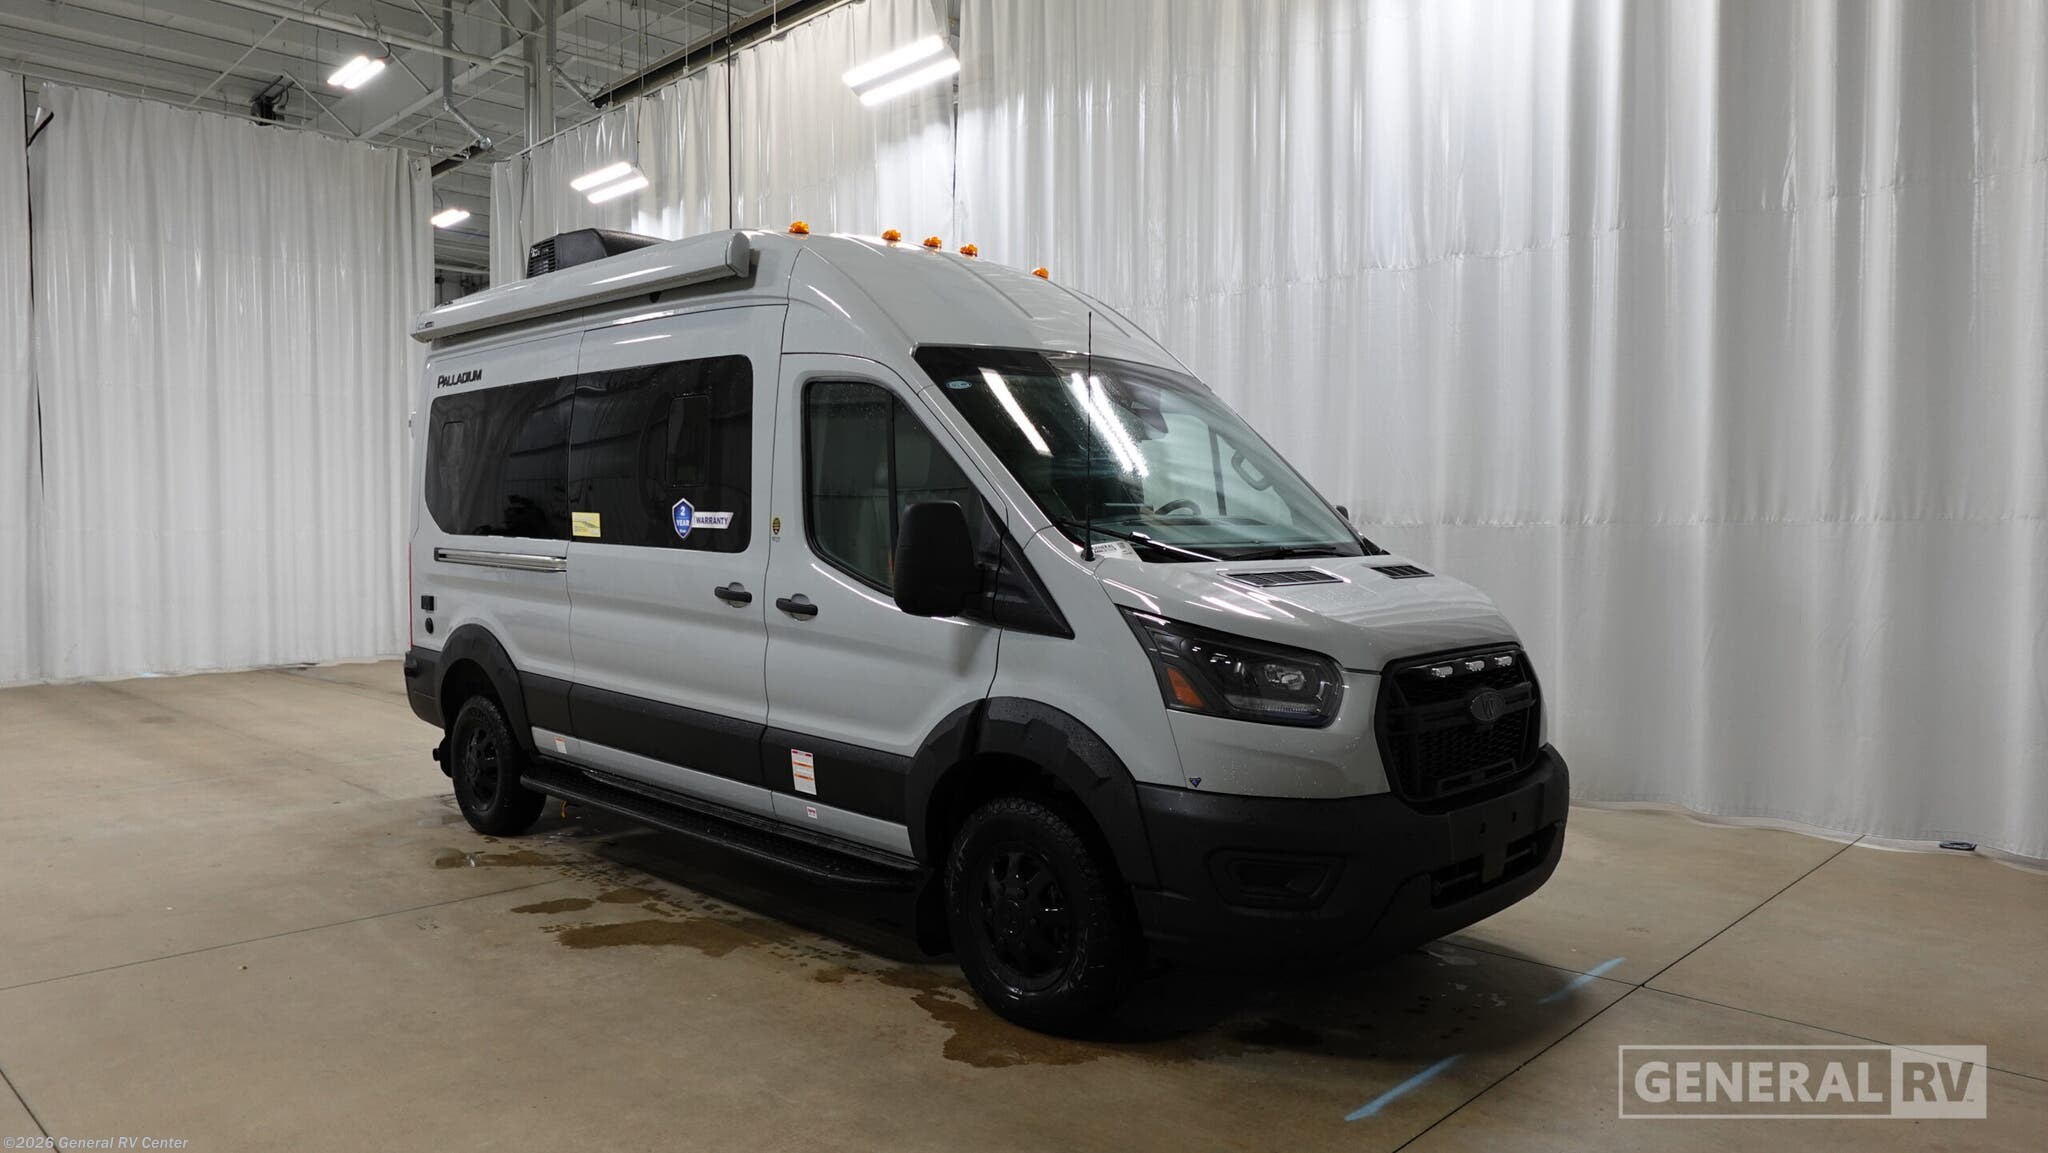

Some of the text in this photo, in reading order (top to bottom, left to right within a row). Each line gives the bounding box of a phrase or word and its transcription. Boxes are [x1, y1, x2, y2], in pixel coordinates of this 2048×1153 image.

[437, 368, 482, 389] PALLADIUM
[680, 505, 686, 517] 2
[676, 519, 690, 527] YEAR
[696, 516, 729, 525] WARRANTY
